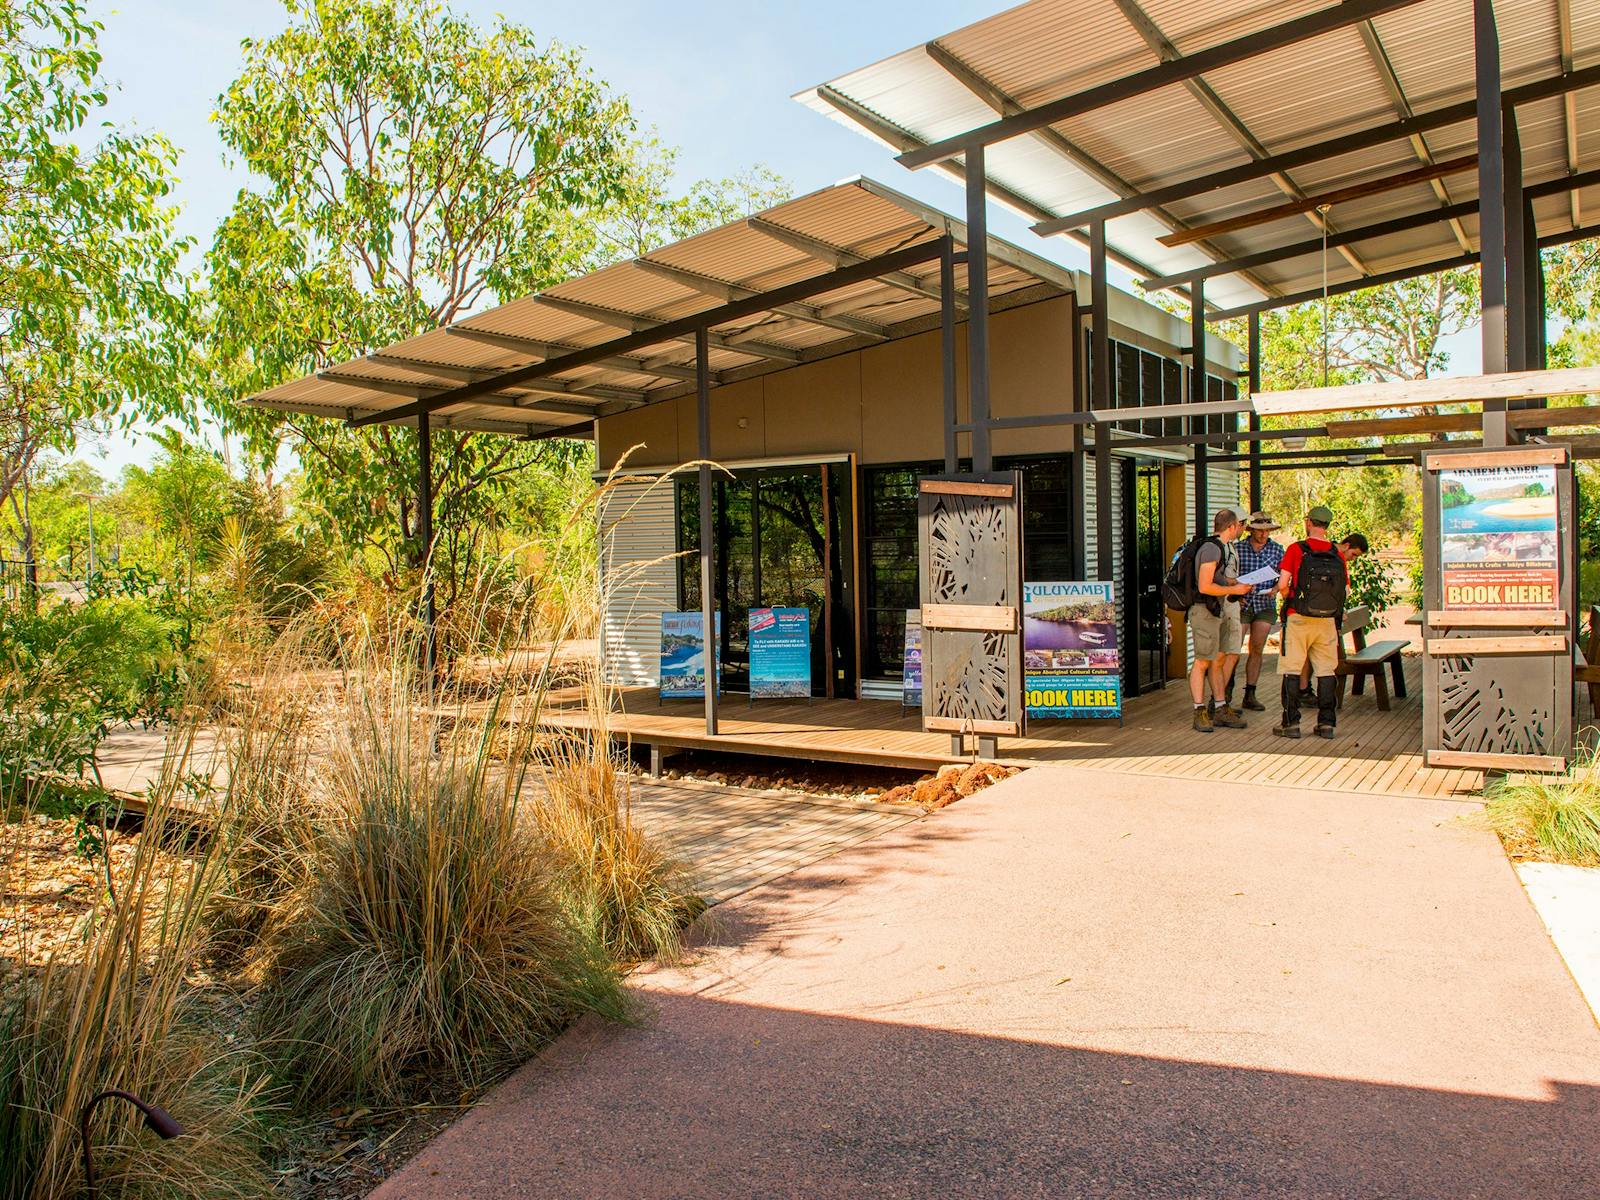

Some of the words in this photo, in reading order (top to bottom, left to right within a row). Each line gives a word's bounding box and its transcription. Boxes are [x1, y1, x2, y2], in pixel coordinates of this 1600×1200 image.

[1448, 585, 1501, 604] BOOK
[1505, 585, 1553, 603] HERE
[1072, 690, 1117, 706] HERE
